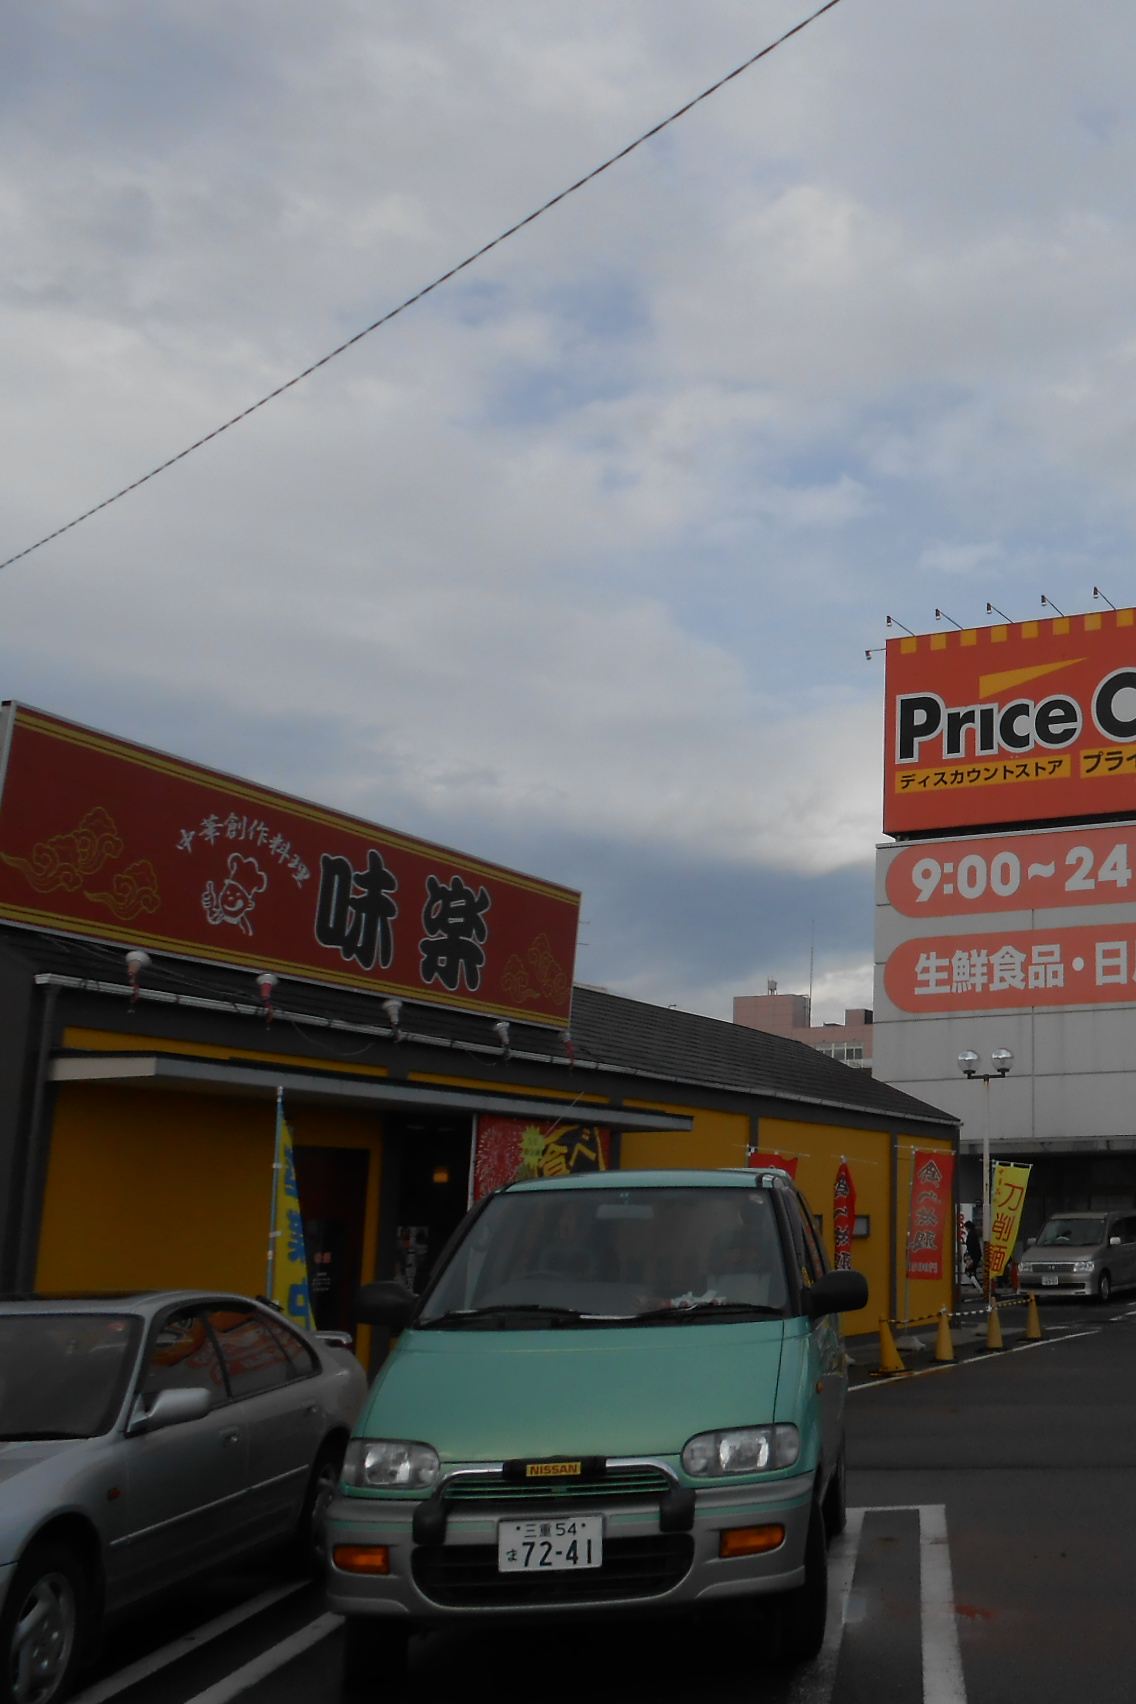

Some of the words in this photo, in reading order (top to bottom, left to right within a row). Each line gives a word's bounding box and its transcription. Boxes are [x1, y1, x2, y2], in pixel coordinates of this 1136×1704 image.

[896, 692, 1082, 765] Price
[900, 759, 1064, 789] ディスカウントストア
[530, 1464, 577, 1475] NISSAN
[522, 1539, 592, 1567] 72-41
